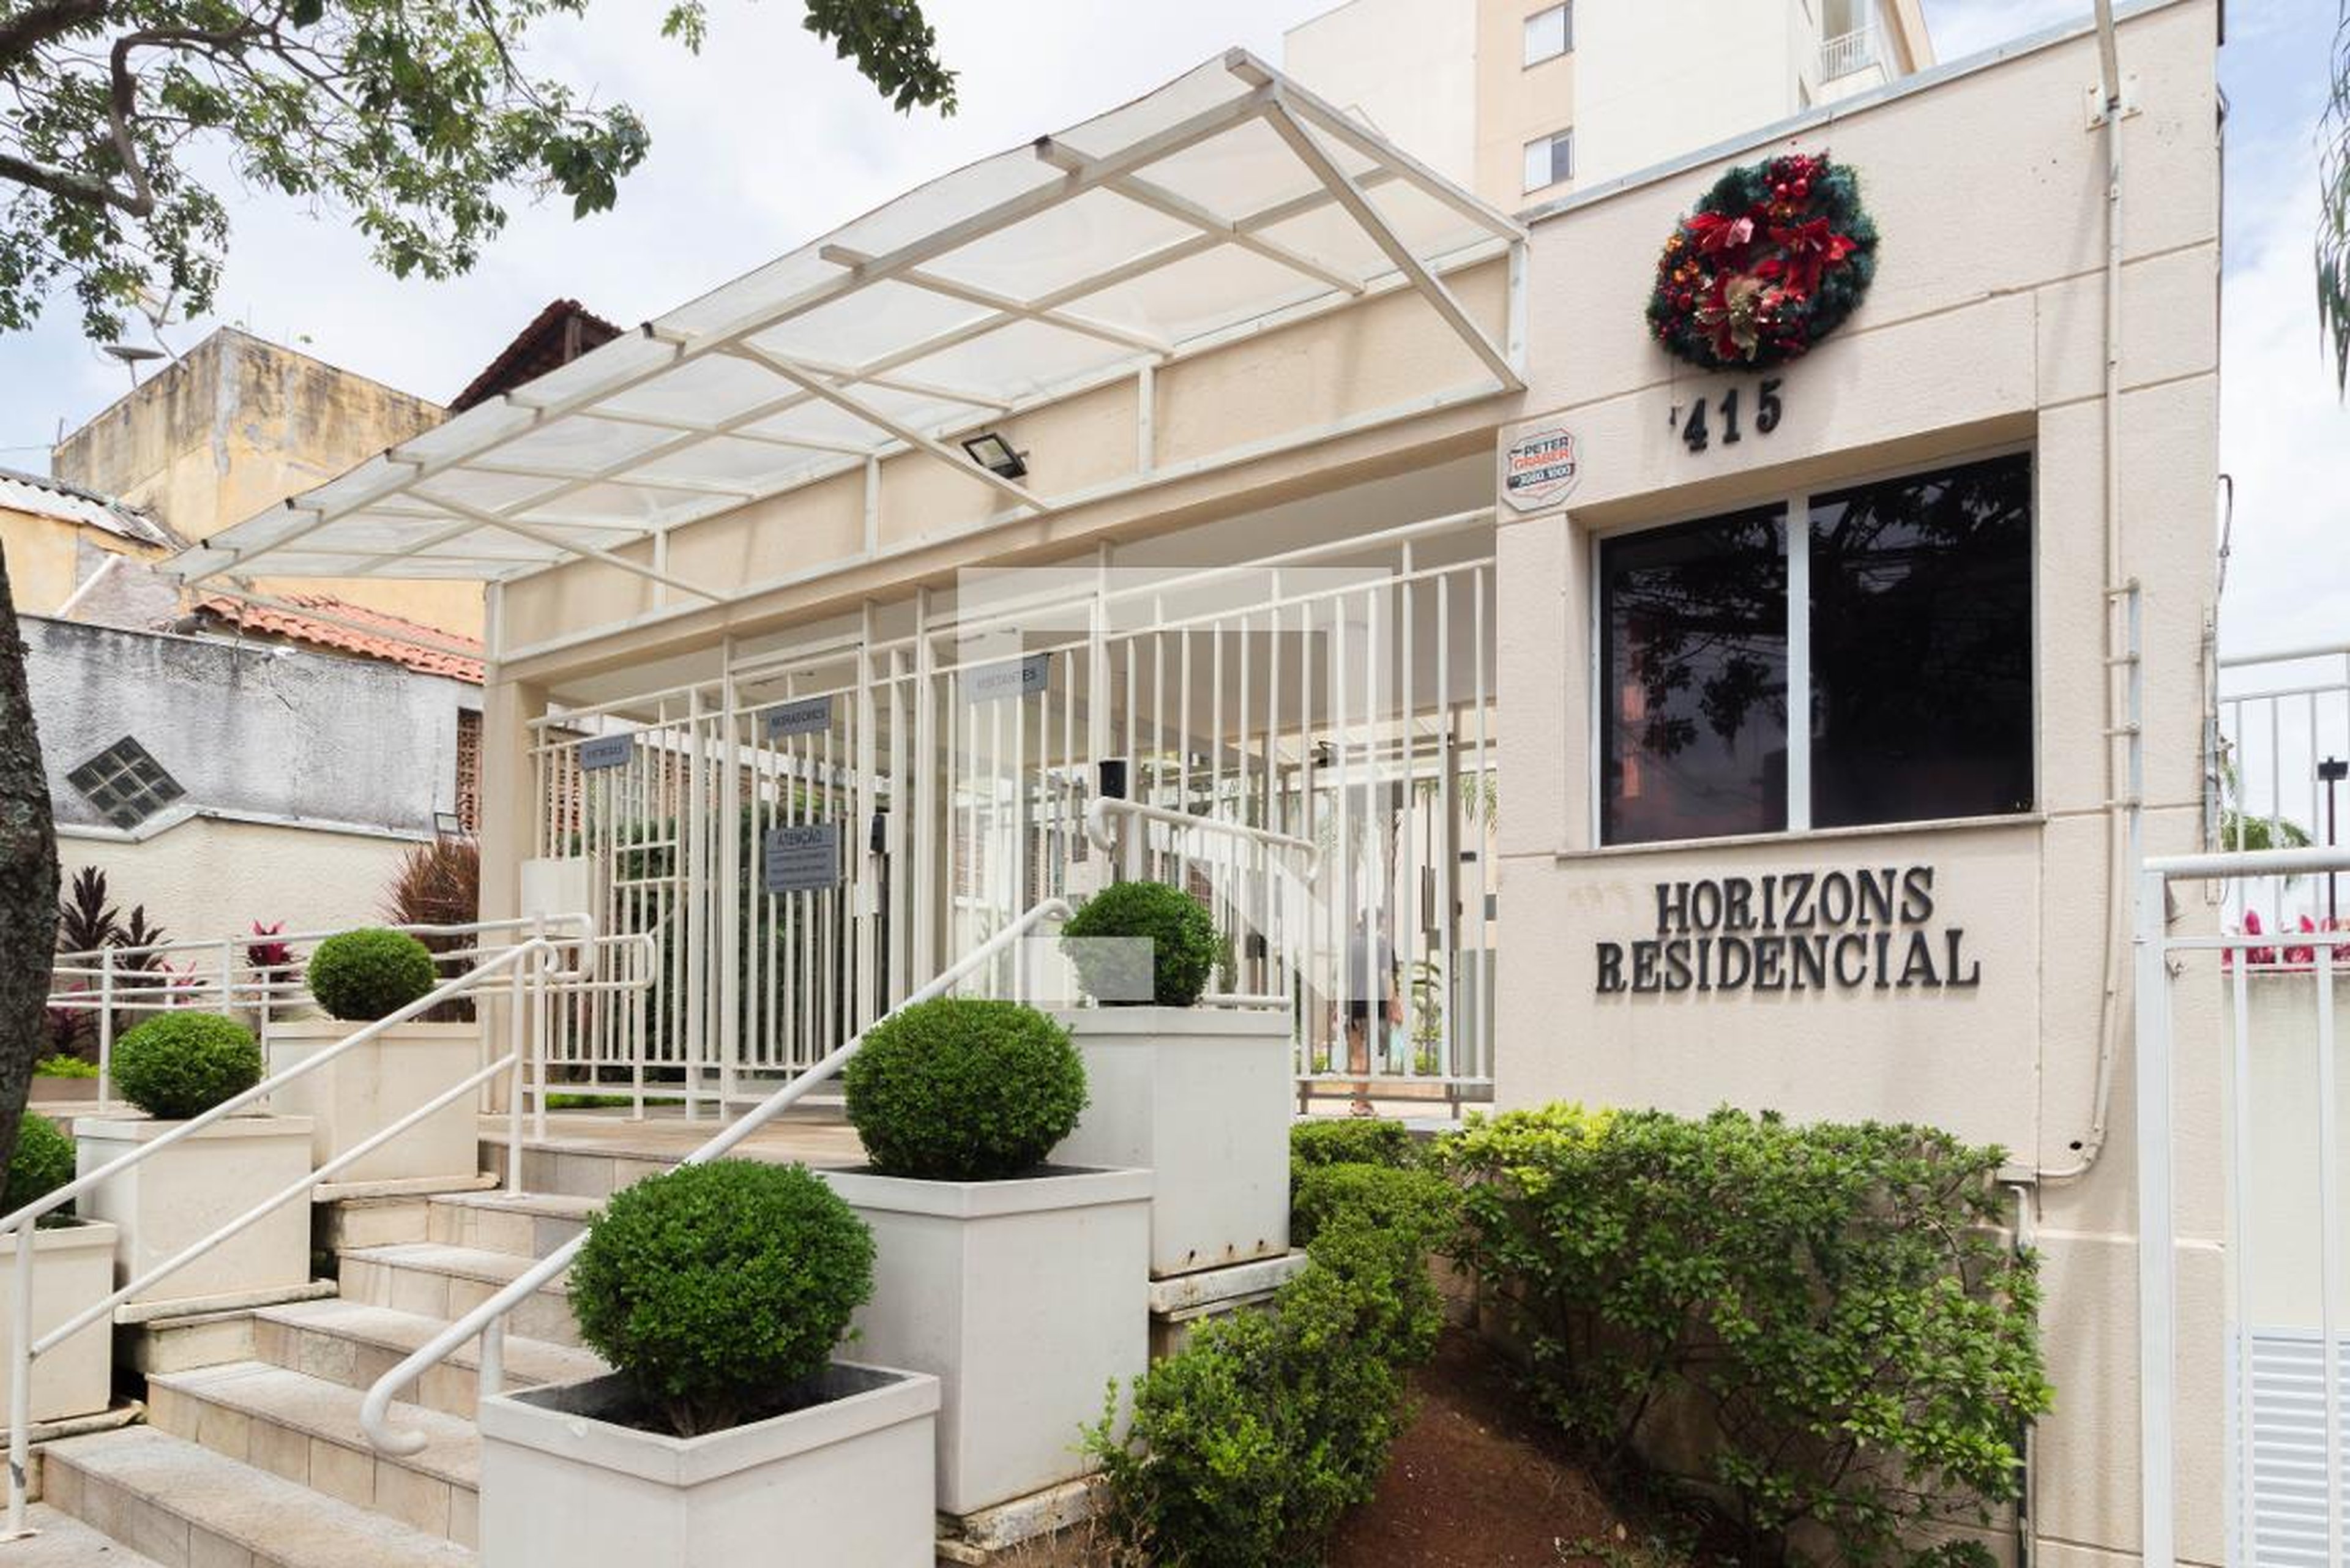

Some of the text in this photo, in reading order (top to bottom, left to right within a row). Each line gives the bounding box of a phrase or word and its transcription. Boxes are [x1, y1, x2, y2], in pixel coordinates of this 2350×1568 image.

[1524, 436, 1569, 457] PETER
[1683, 378, 1782, 453] 415
[777, 828, 822, 846] ATENÇÃO
[1655, 866, 1934, 934] HORIZONS
[1595, 928, 1980, 994] RESIDENCIAL
